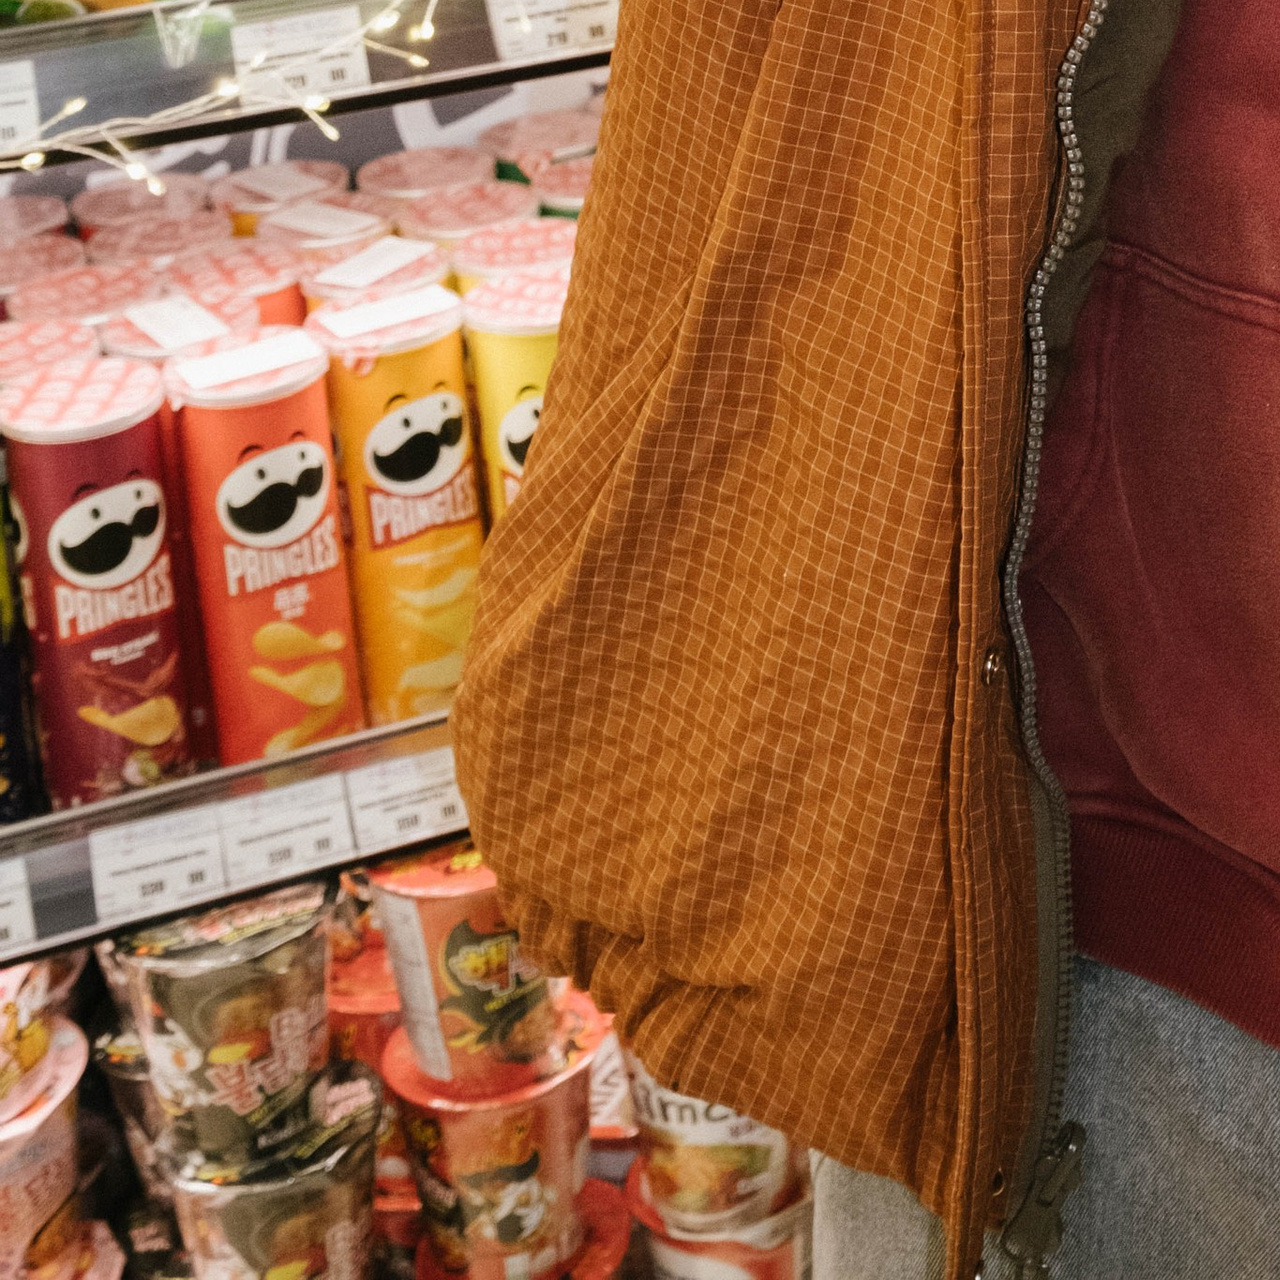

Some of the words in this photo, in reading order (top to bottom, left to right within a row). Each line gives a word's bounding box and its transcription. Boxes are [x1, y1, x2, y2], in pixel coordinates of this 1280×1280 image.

[370, 466, 478, 545] PRINGLES
[55, 552, 173, 640] PRINGLES
[223, 514, 338, 597] PRINGLES
